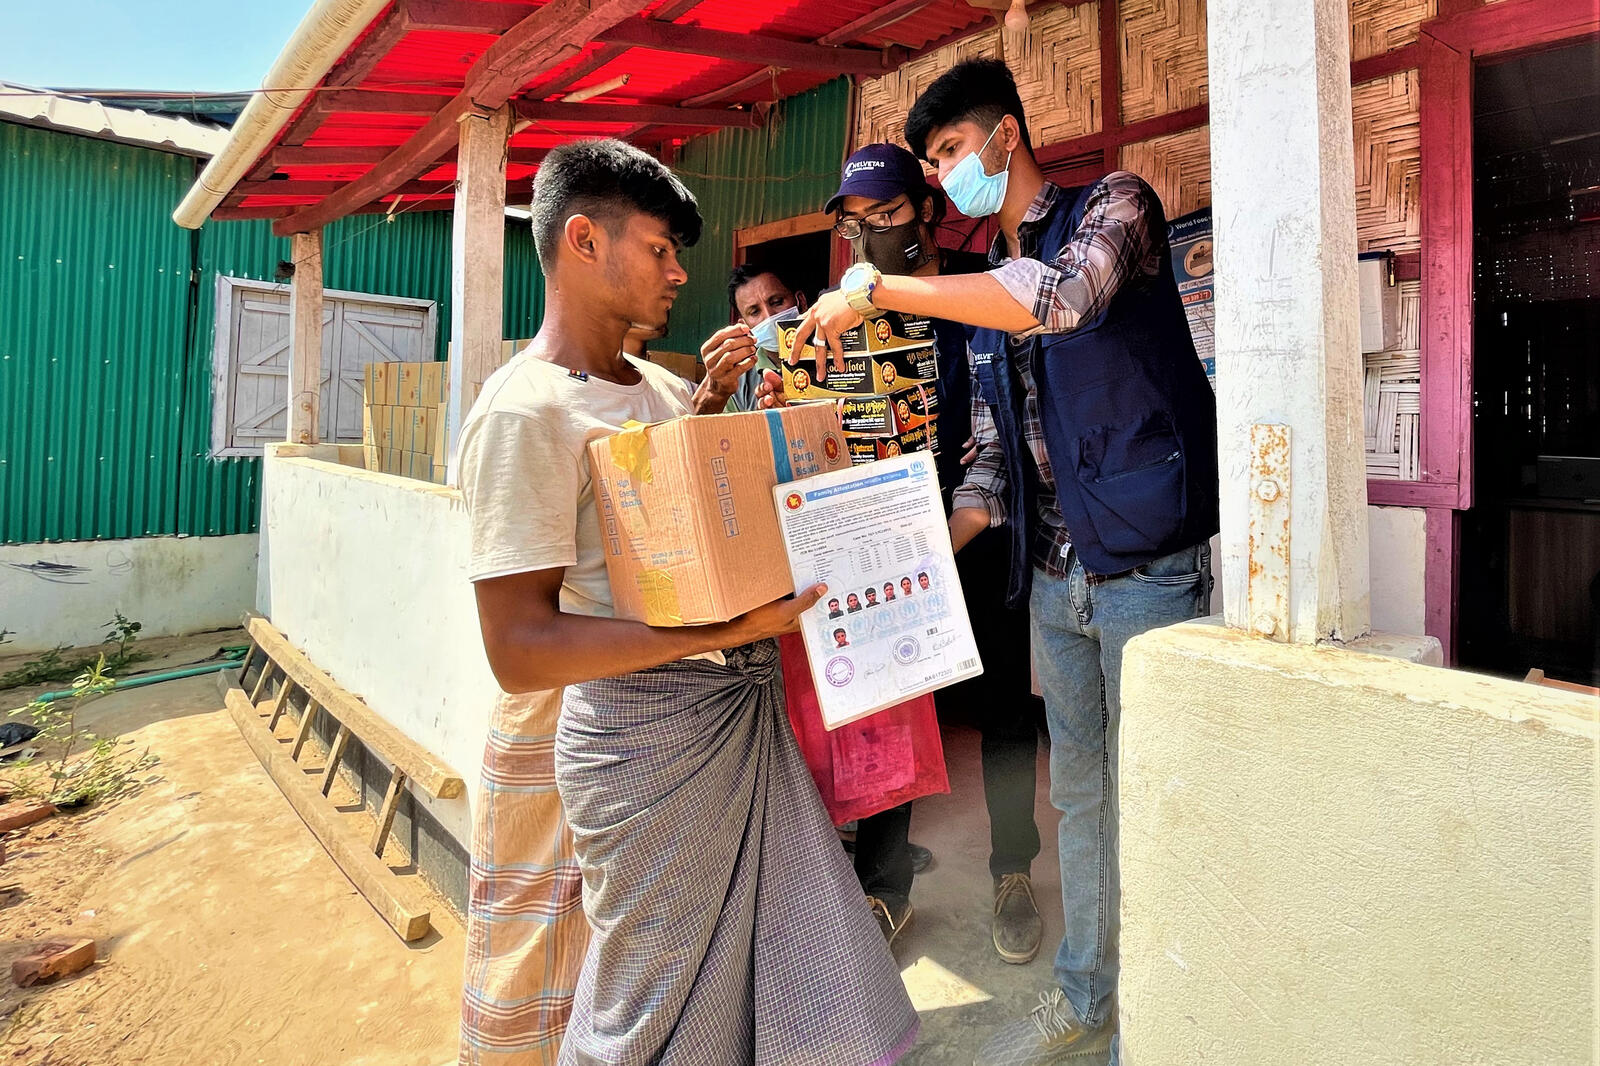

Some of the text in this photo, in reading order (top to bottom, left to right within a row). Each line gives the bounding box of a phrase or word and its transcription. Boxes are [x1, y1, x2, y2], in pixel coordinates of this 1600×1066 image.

[852, 161, 885, 169] HELVETAS
[1175, 220, 1193, 230] World
[790, 439, 805, 449] High
[814, 481, 864, 497] Family Attestation
